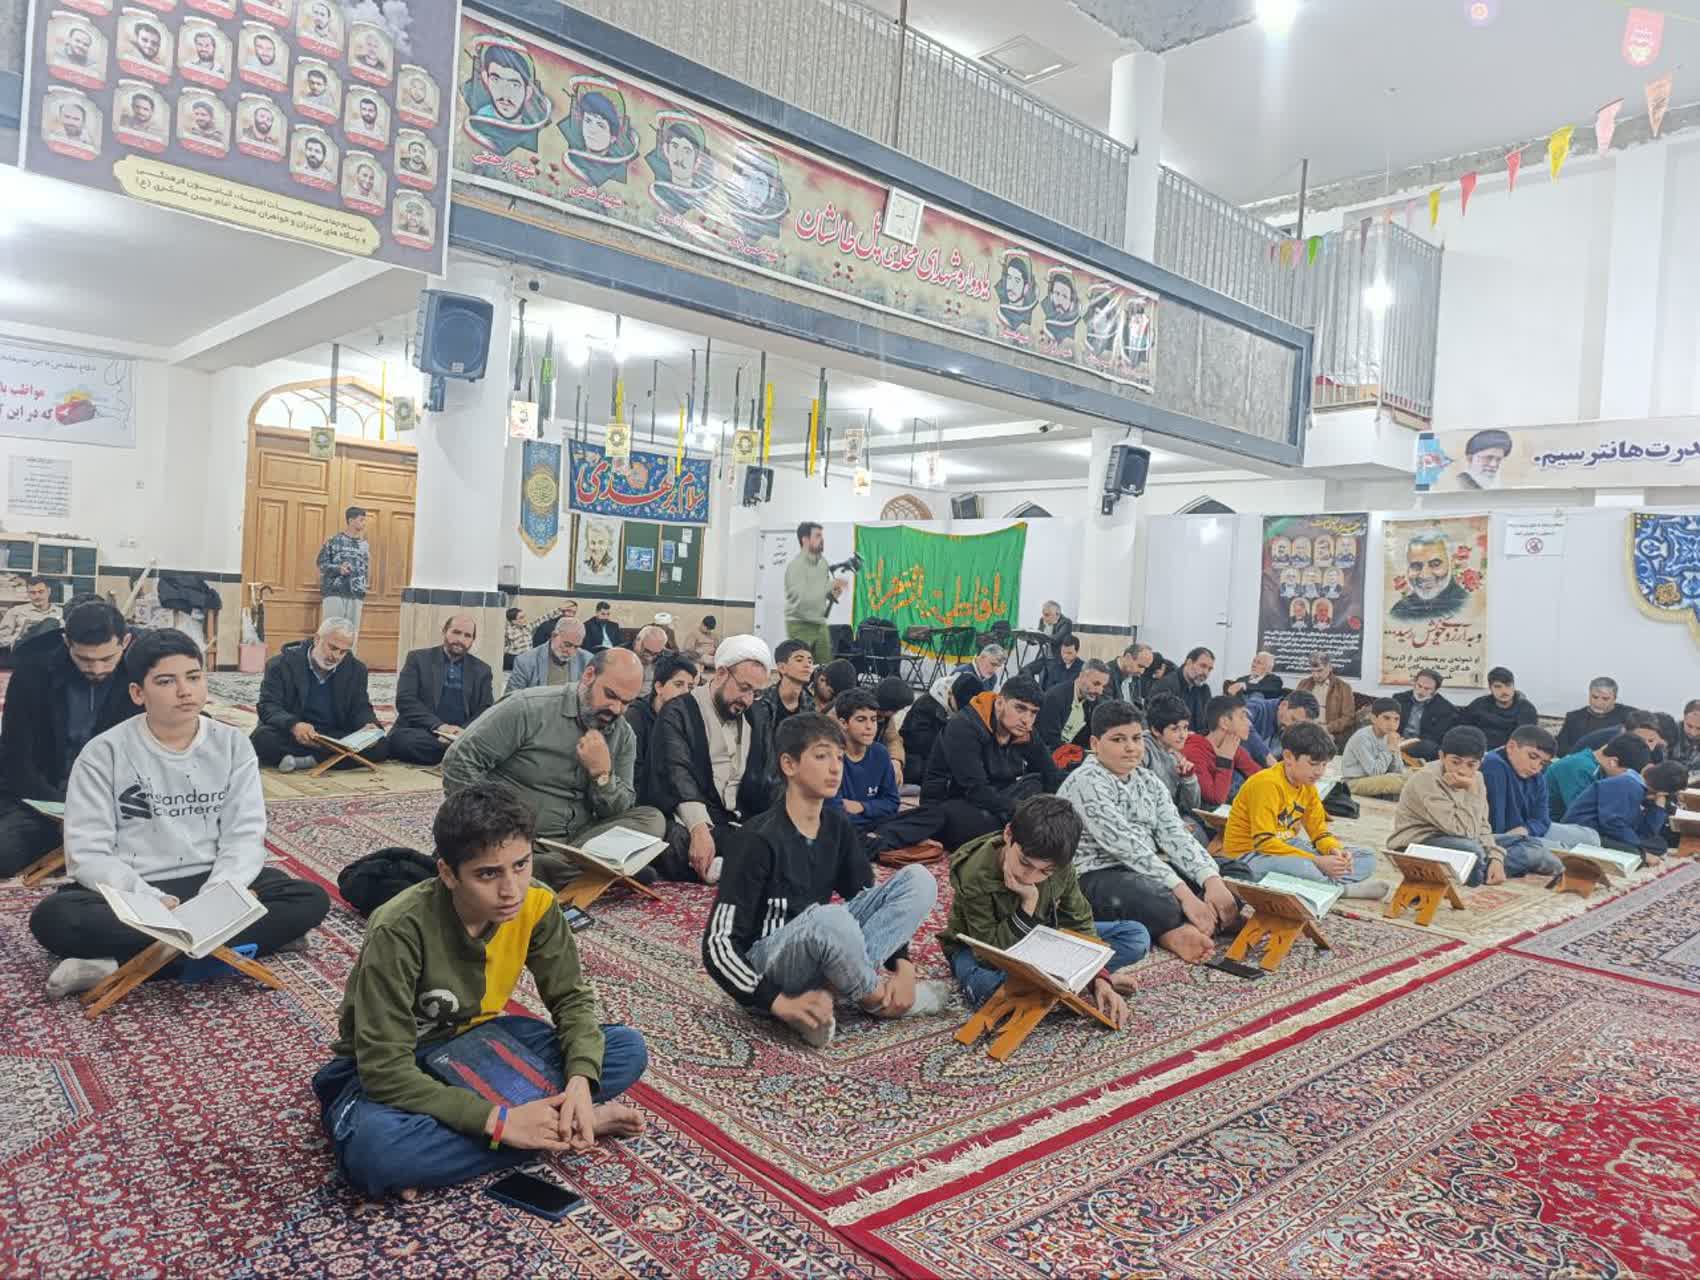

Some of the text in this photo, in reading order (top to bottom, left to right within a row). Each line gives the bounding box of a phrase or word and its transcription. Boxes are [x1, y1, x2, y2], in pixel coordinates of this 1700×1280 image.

[794, 200, 856, 253] طالشان
[854, 210, 882, 265] پل
[7, 405, 24, 421] این
[10, 382, 48, 401] مواظب
[28, 407, 40, 423] در
[41, 407, 54, 421] که
[575, 460, 675, 506] مهدی
[678, 471, 705, 514] سلام
[992, 571, 1007, 617] یا
